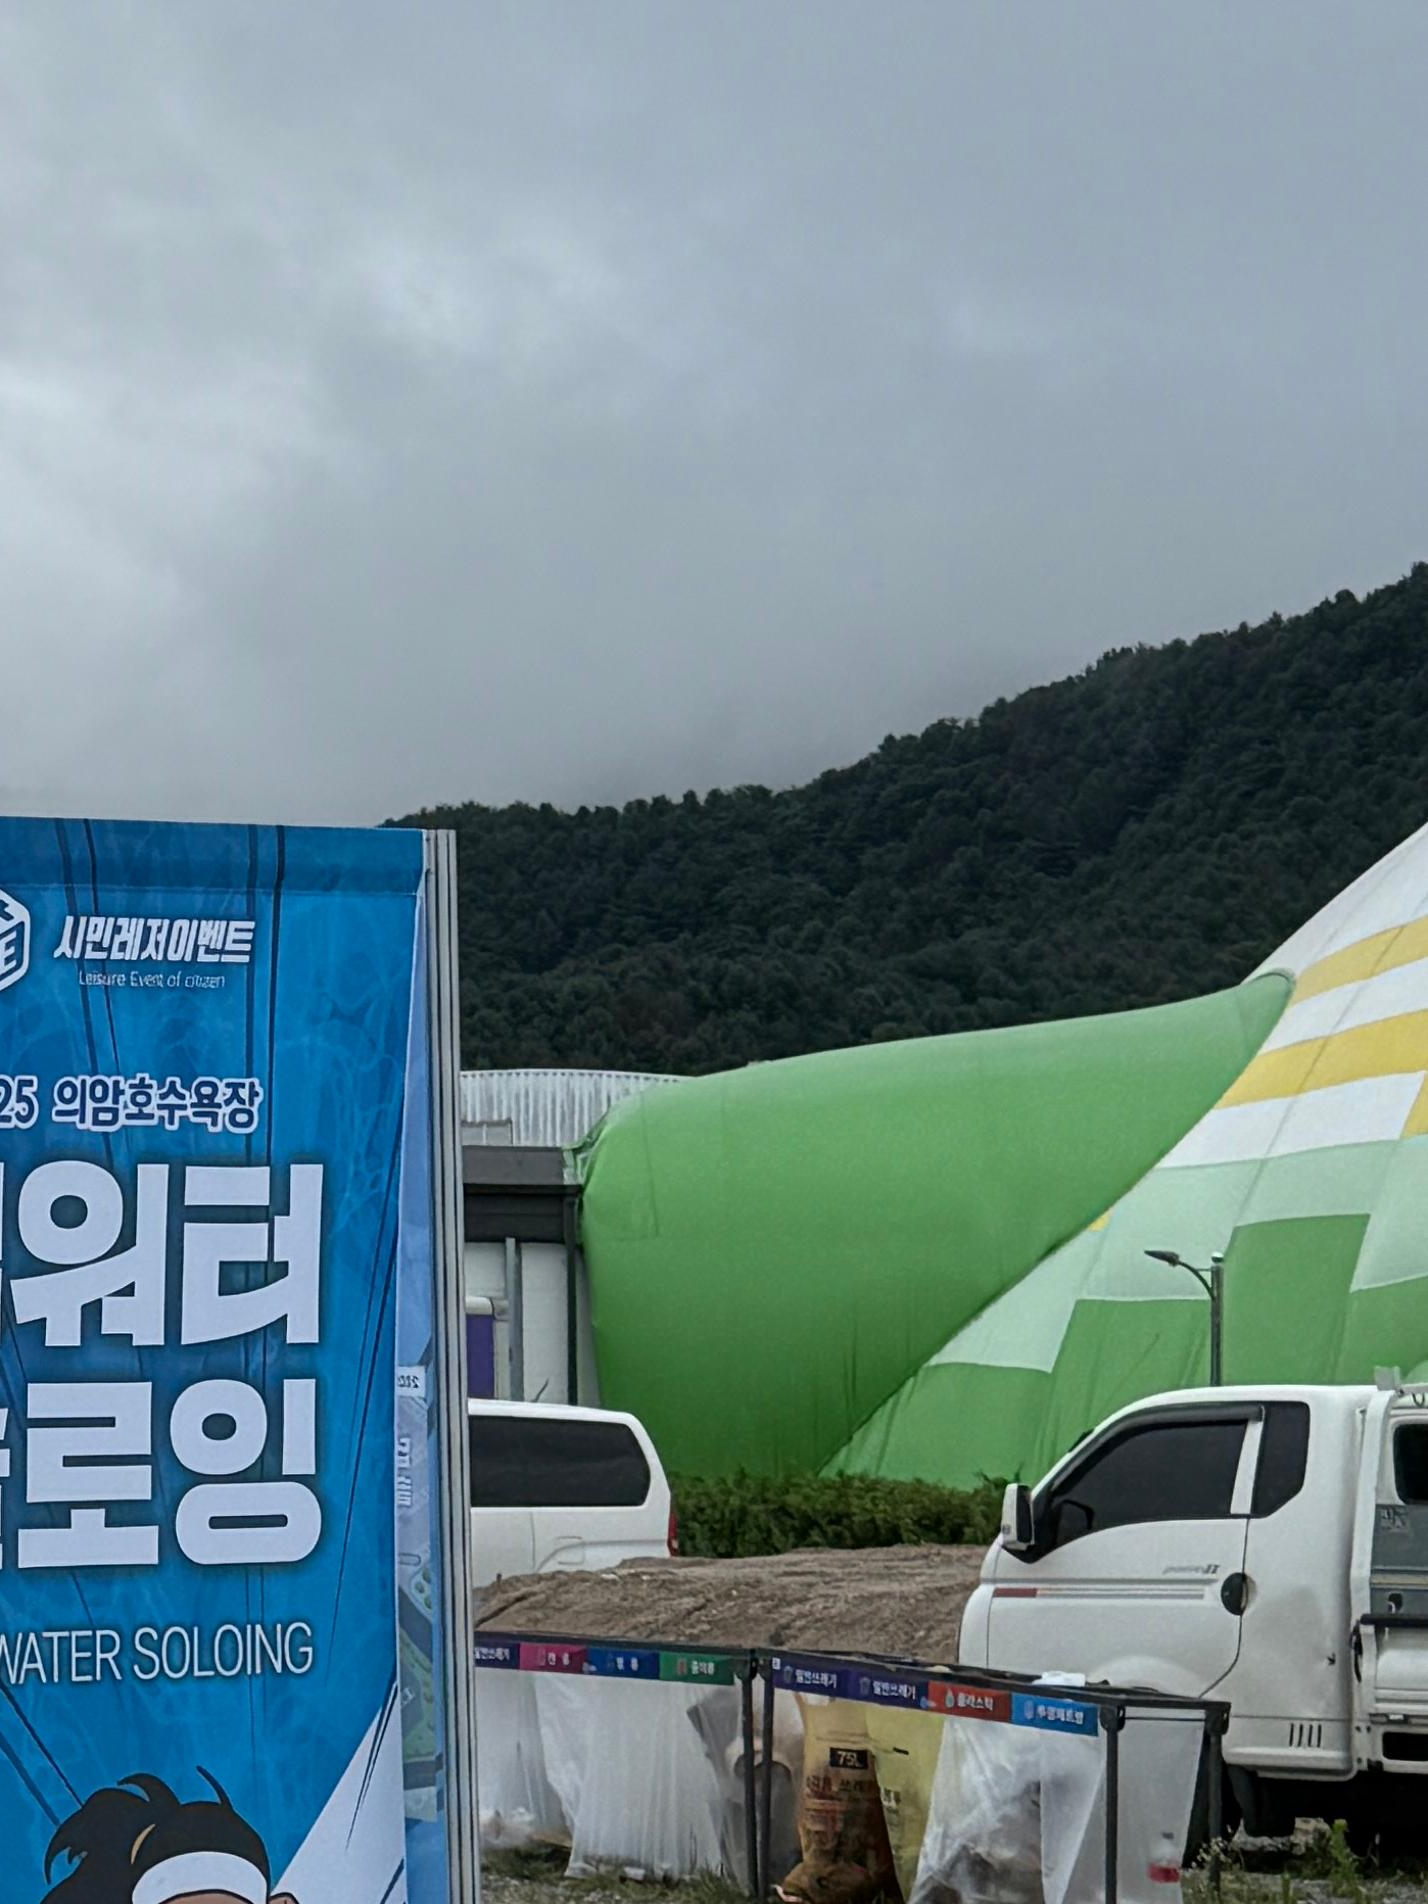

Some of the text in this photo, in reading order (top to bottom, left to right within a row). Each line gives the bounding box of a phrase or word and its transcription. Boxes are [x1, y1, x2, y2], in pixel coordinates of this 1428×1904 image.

[53, 915, 256, 963] 시민레저이벤트
[79, 970, 126, 986] Leisure
[167, 970, 181, 987] of
[51, 1072, 264, 1133] 의암호수욕장
[133, 1621, 314, 1680] SOLOING
[795, 1668, 837, 1689] 일반쓰레기
[872, 1680, 916, 1700] 일반쓰레기
